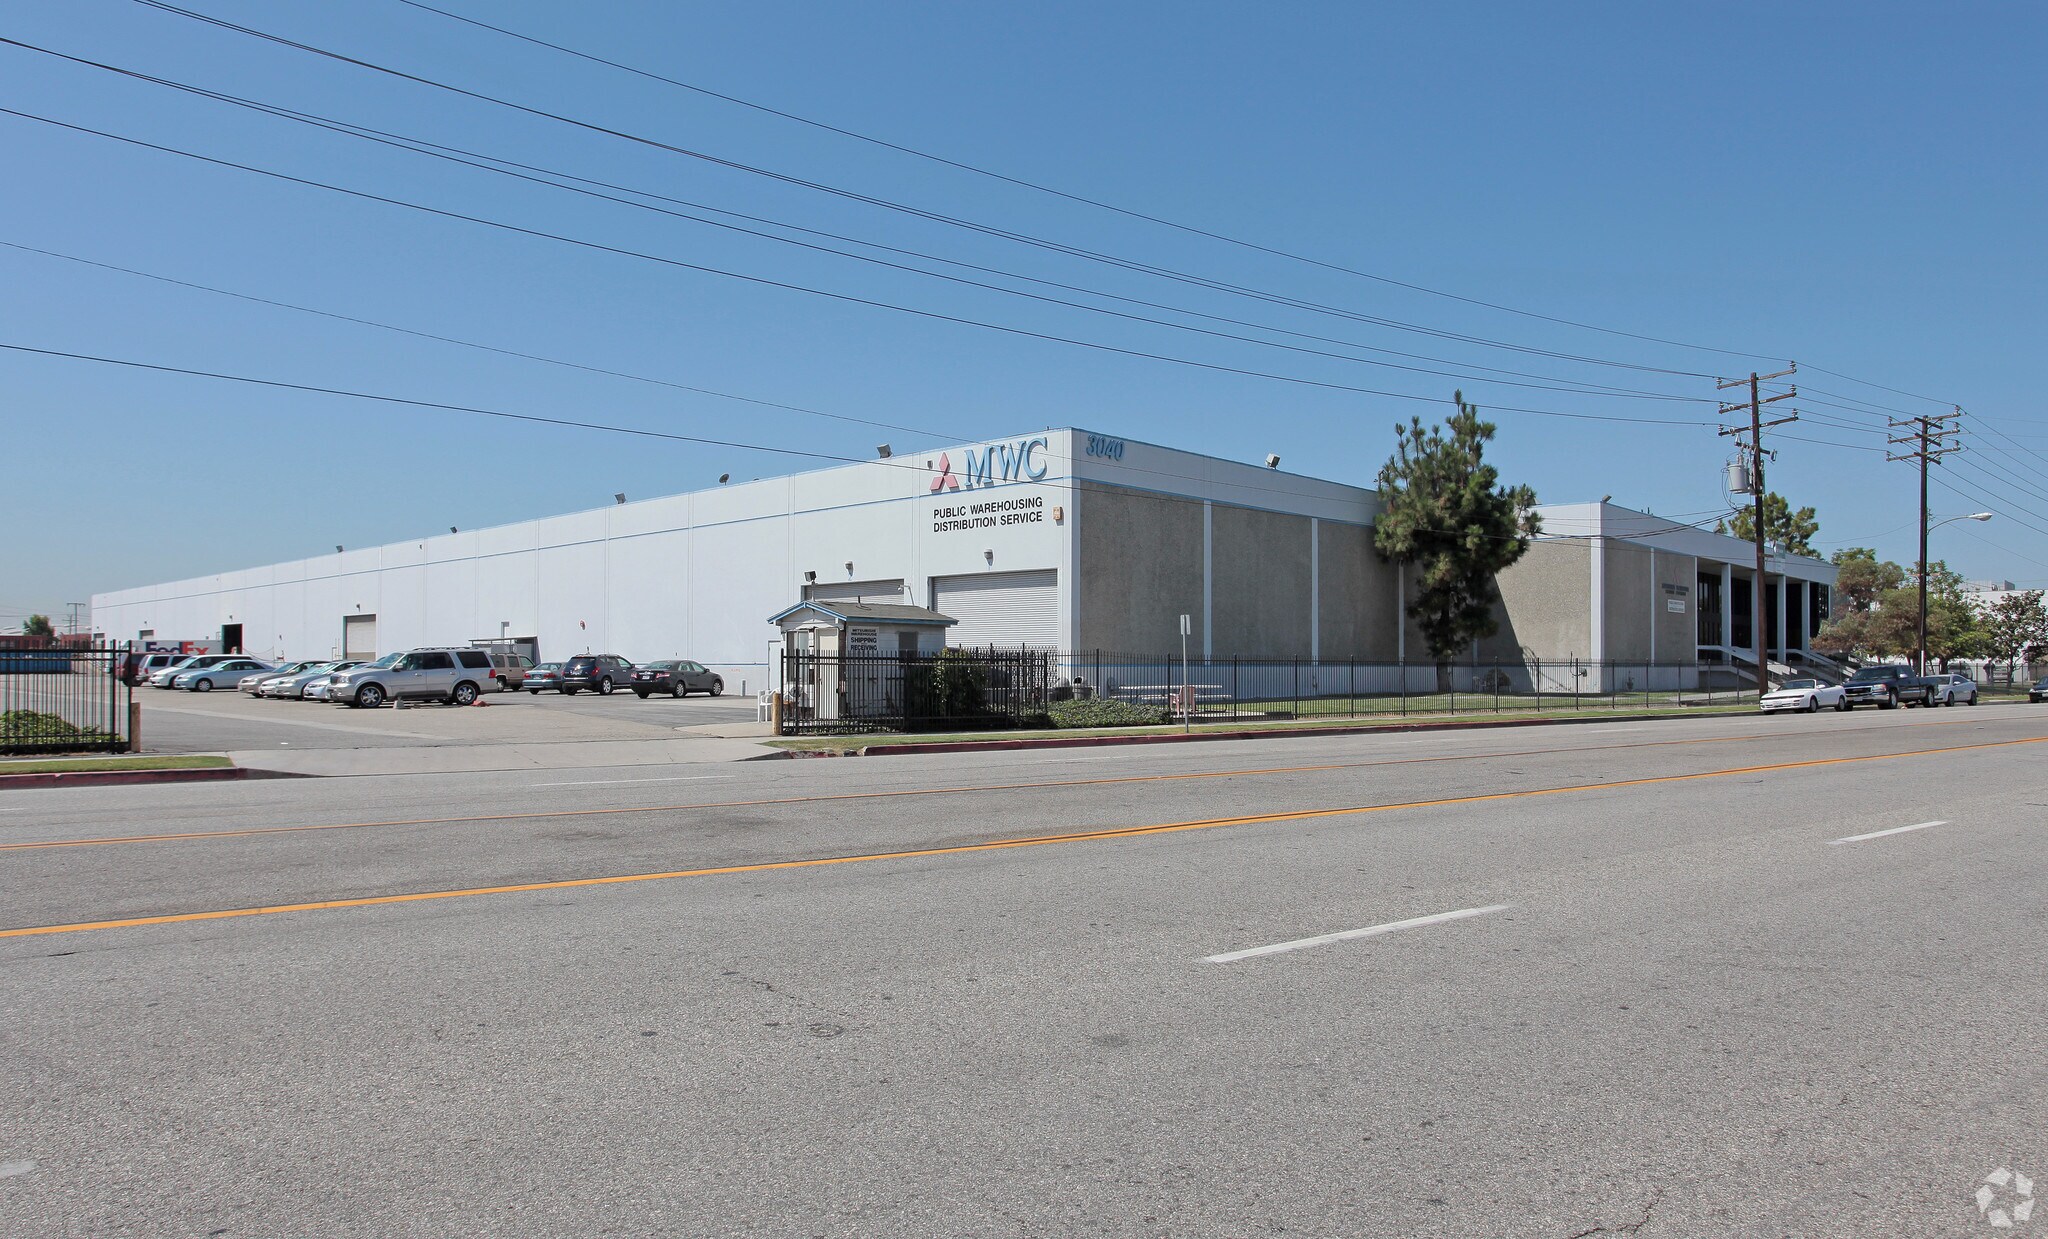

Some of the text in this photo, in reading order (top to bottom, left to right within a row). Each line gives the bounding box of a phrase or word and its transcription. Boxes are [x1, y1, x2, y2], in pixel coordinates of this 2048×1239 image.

[1086, 434, 1125, 462] 3040
[964, 437, 1048, 489] MWC
[933, 496, 1043, 520] PUBLIC WAREHOUSING
[933, 510, 1043, 533] DISTRIBUTION SERVICE
